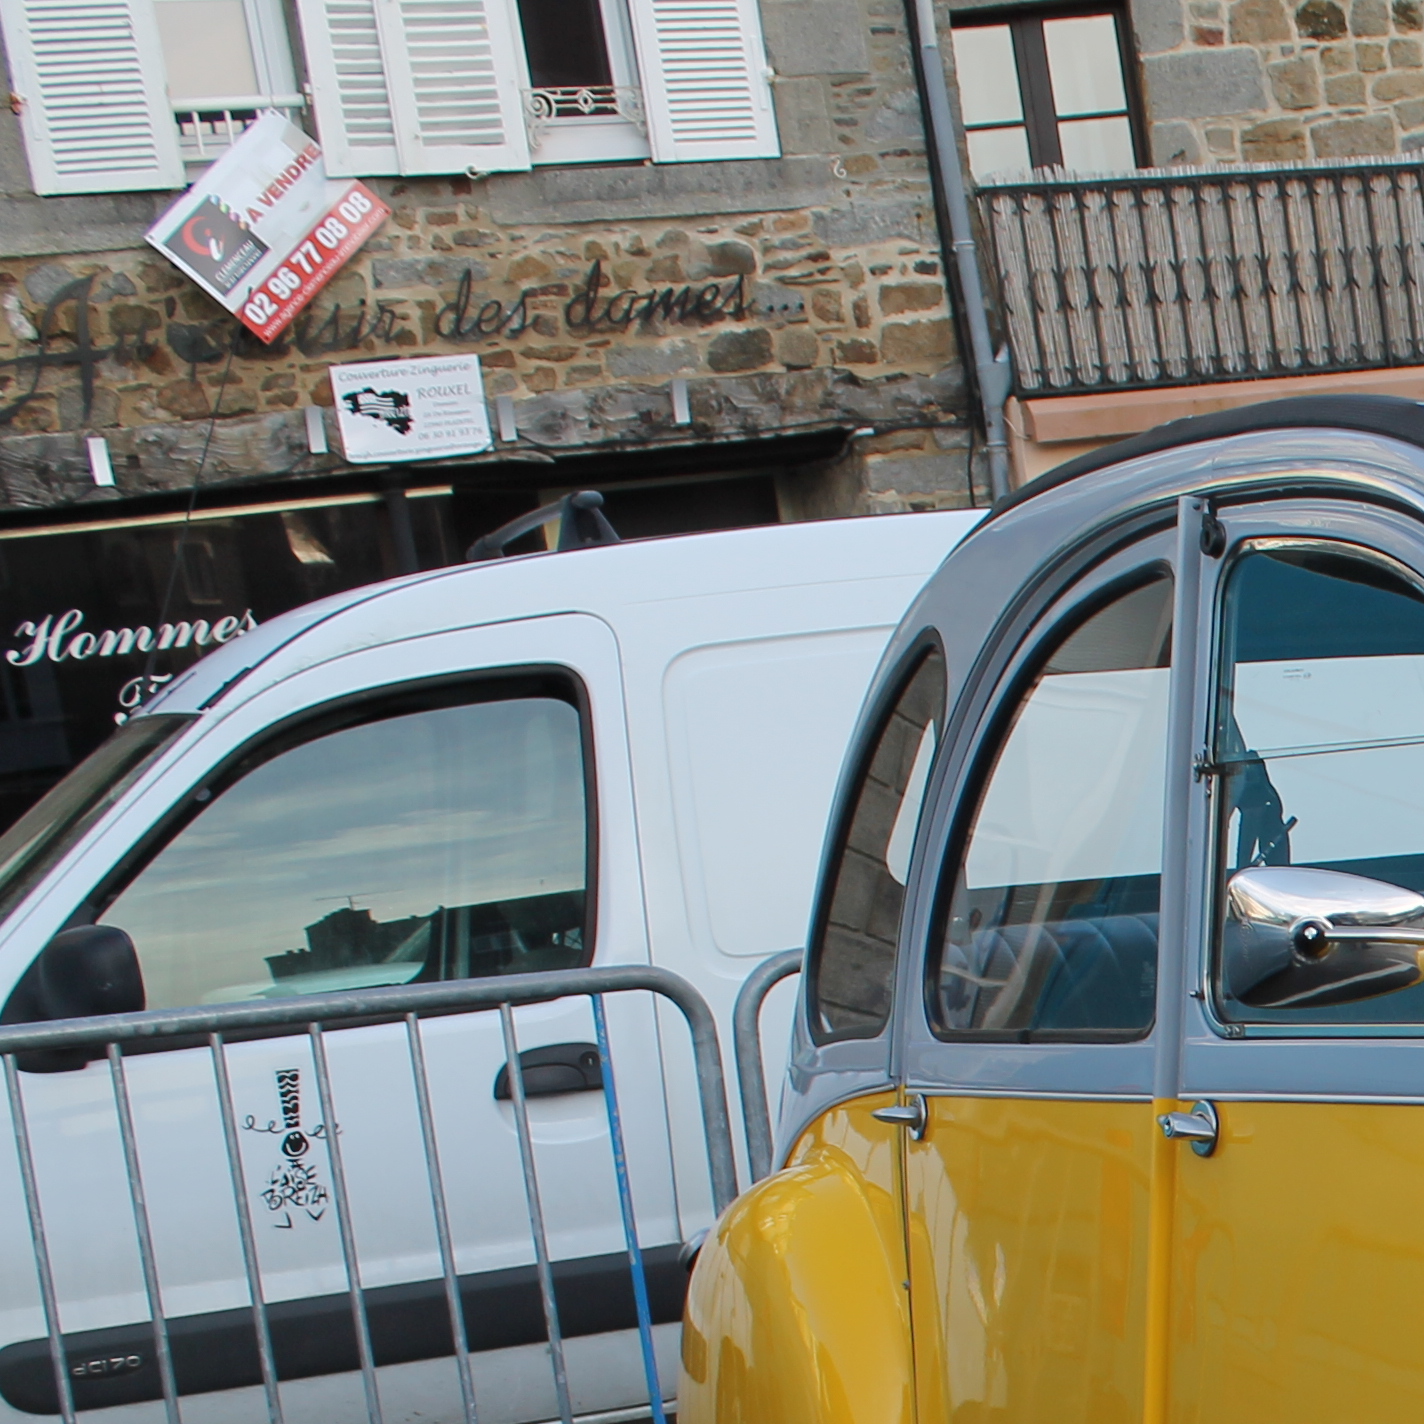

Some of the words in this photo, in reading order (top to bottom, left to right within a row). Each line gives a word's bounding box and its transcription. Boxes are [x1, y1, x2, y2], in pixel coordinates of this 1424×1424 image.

[246, 207, 265, 224] A
[258, 142, 322, 208] VENDRE
[244, 292, 279, 326] 02
[267, 266, 301, 300] 96
[291, 241, 324, 275] 77
[315, 217, 349, 250] 08
[339, 191, 373, 224] 08
[434, 268, 541, 339] des
[415, 383, 472, 399] ROUXEL
[6, 608, 262, 666] Hommes
